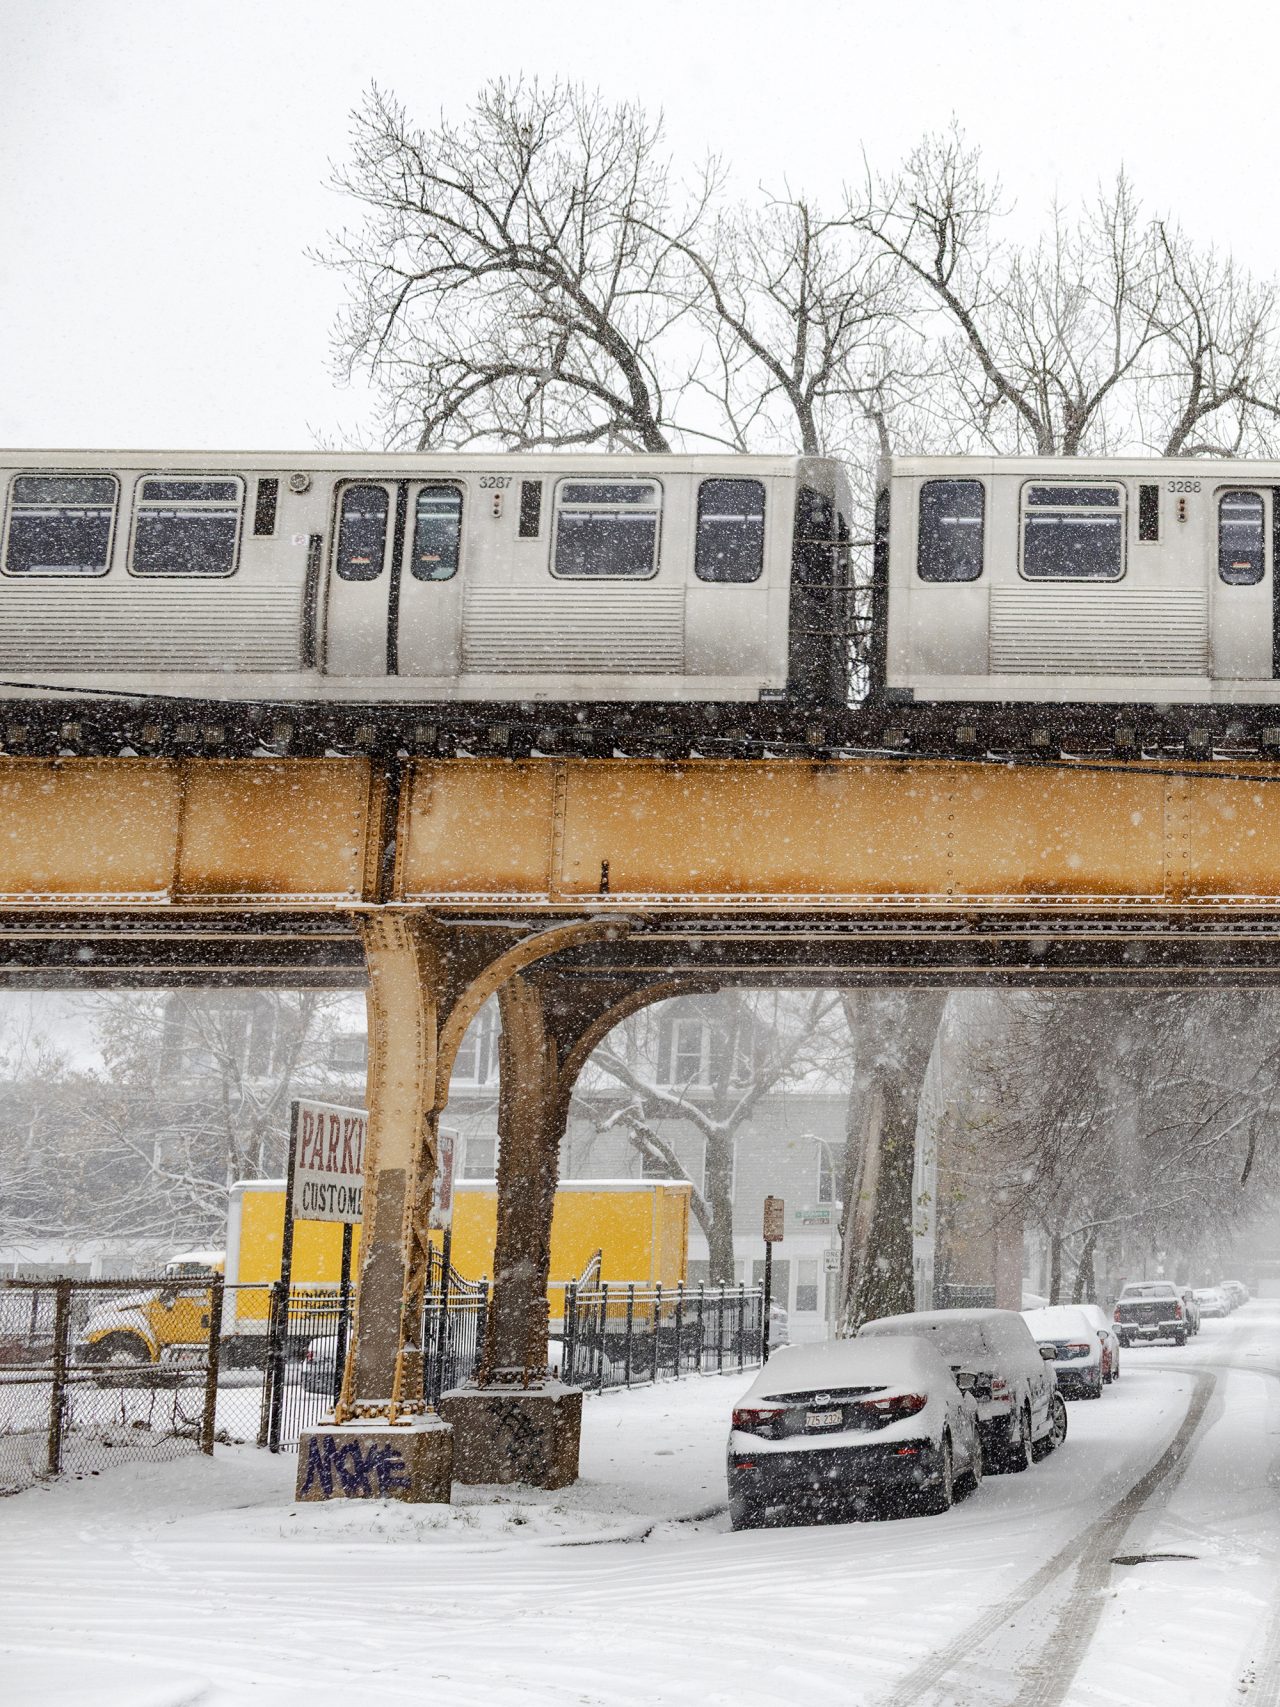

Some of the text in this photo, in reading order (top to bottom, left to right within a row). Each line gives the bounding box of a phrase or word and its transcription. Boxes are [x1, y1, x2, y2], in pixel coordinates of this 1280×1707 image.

[479, 476, 513, 489] 3287
[1167, 480, 1202, 493] 3288
[299, 1109, 368, 1175] PARKI
